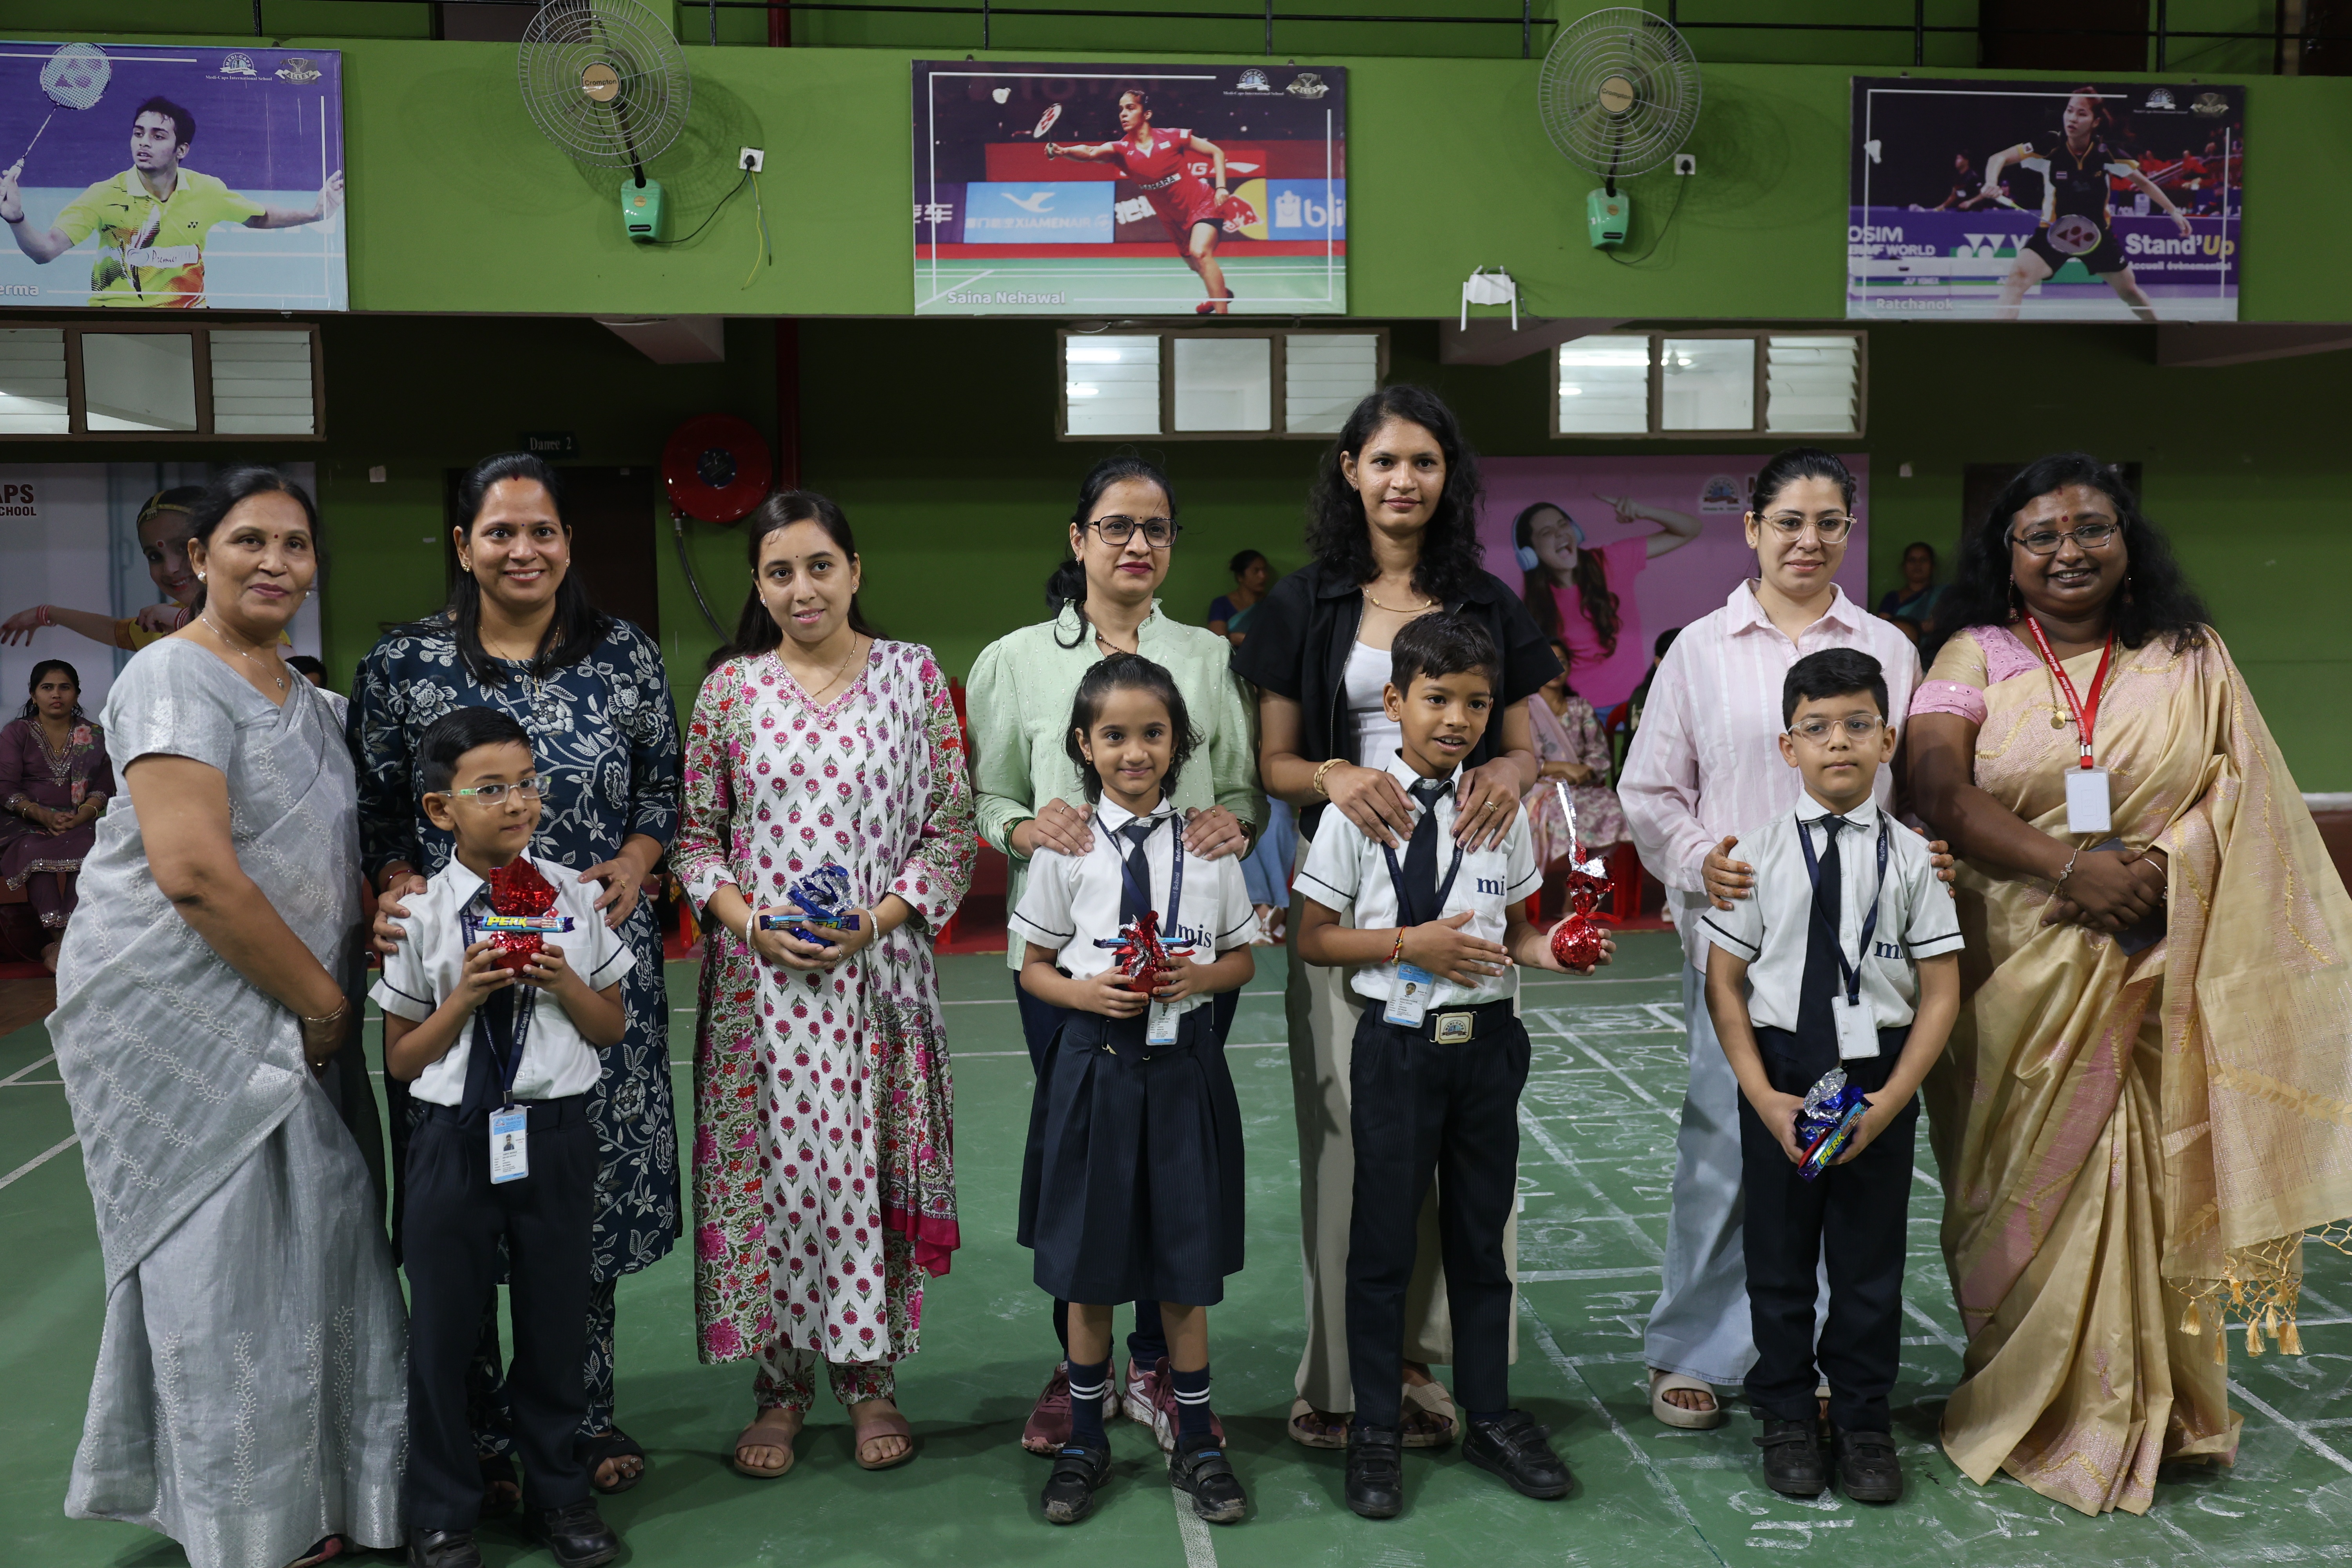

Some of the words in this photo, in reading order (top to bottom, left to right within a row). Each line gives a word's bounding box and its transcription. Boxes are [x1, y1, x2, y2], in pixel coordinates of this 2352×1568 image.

[225, 55, 251, 68] MEDI-CAPS
[1886, 244, 1936, 256] WORLD
[947, 289, 992, 304] Saina
[996, 290, 1065, 304] Nehawal
[1876, 297, 1953, 310] Ratchanok
[566, 436, 572, 450] 2
[0, 484, 34, 504] PS
[2028, 617, 2038, 630] School
[2059, 676, 2070, 690] School
[2066, 690, 2082, 718] International
[486, 916, 527, 928] PERK
[1177, 924, 1212, 948] mis
[1445, 1021, 1464, 1031] MEDI-CAPS
[1819, 1132, 1845, 1165] PERK
